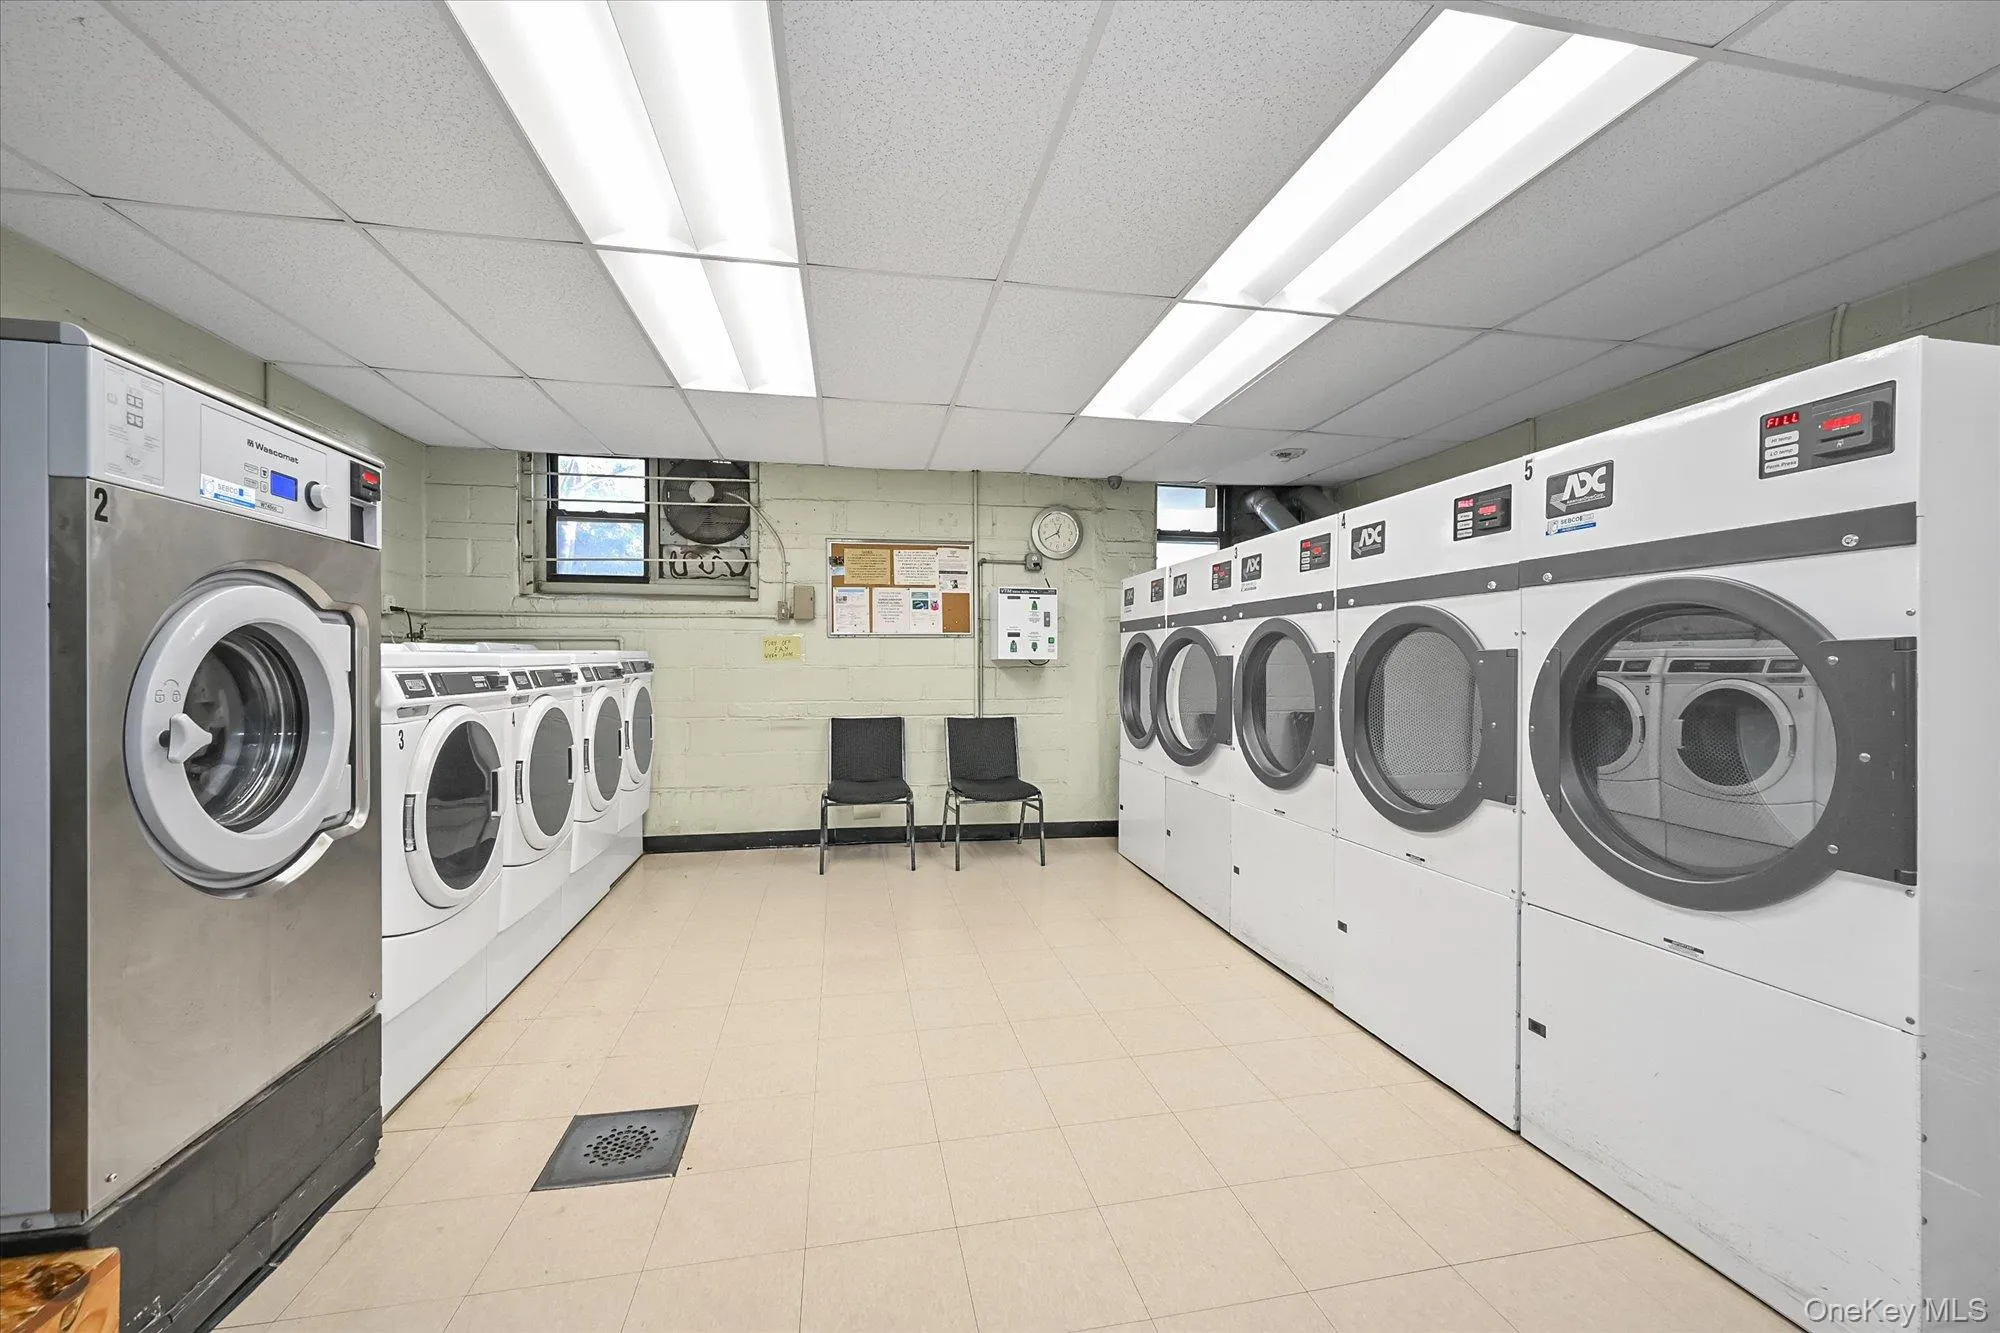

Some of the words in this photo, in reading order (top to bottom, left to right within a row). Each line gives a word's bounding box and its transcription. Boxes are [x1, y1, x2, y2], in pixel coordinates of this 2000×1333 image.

[1767, 412, 1798, 429] FILL
[255, 441, 298, 465] Wascomat
[1524, 459, 1533, 481] 5
[1562, 466, 1606, 501] ADC
[94, 487, 108, 522] 2
[1359, 525, 1382, 548] ADC
[398, 729, 405, 751] 3
